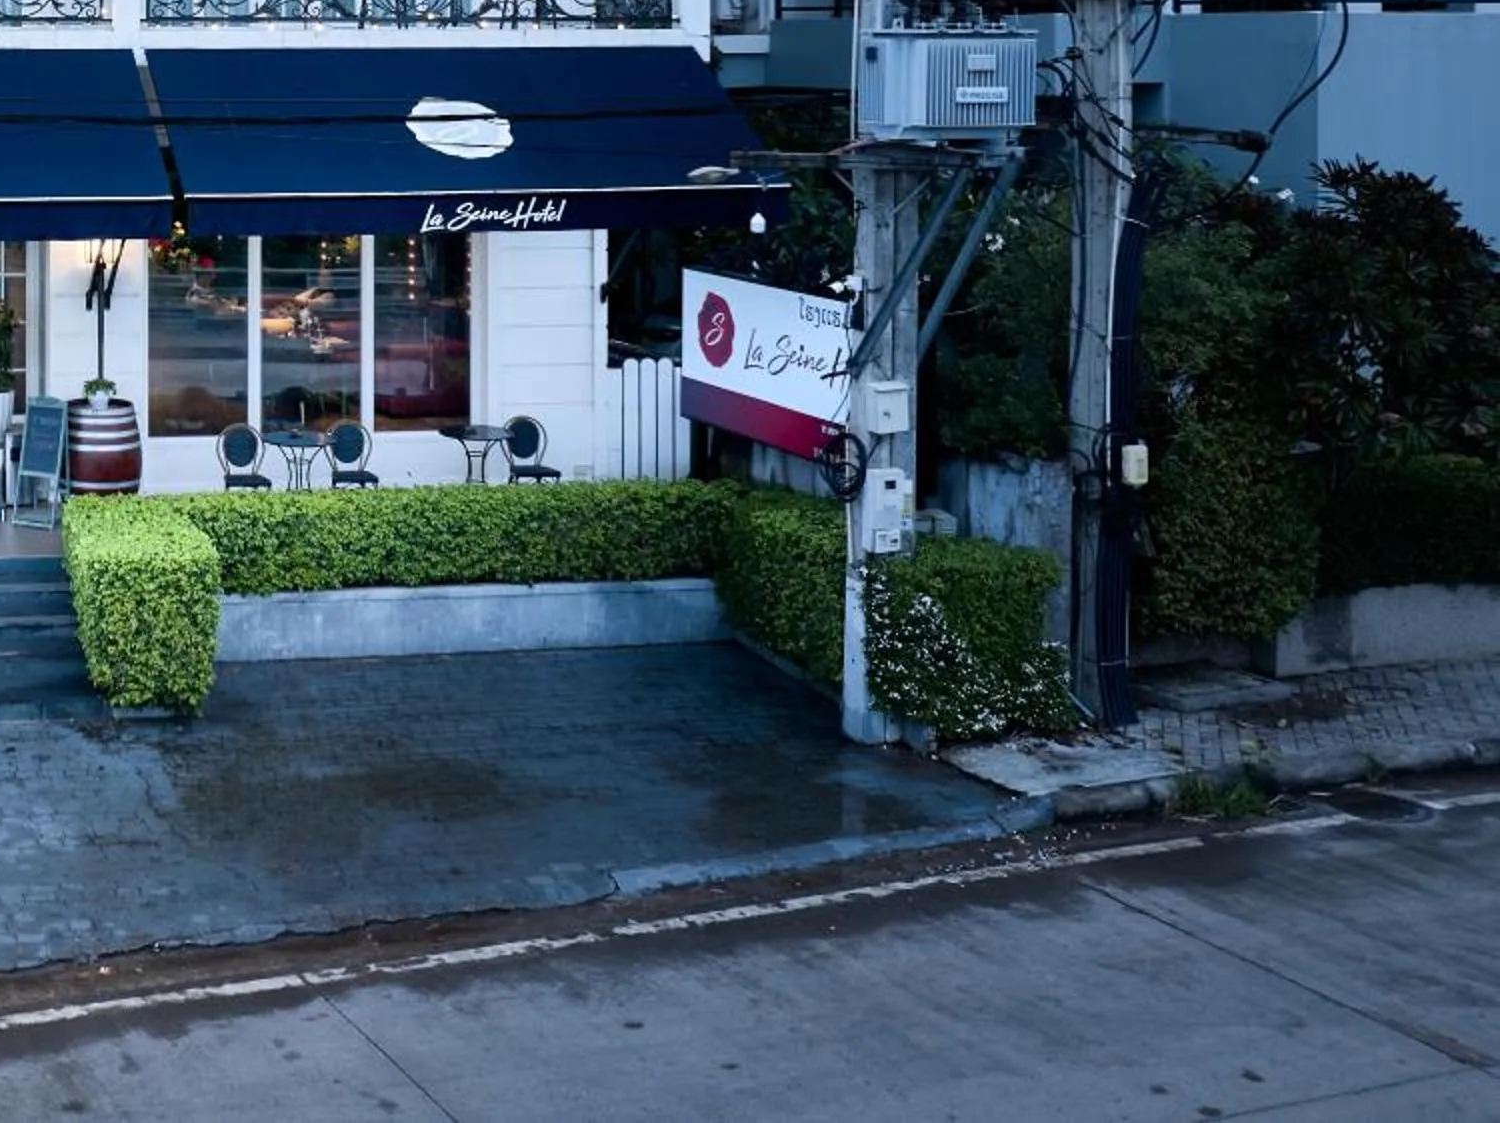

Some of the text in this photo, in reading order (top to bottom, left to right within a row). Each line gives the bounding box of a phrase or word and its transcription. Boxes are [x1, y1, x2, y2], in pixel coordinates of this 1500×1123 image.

[420, 196, 567, 233] La Seine Hotel
[743, 328, 765, 370] La
[767, 334, 828, 376] Seine
